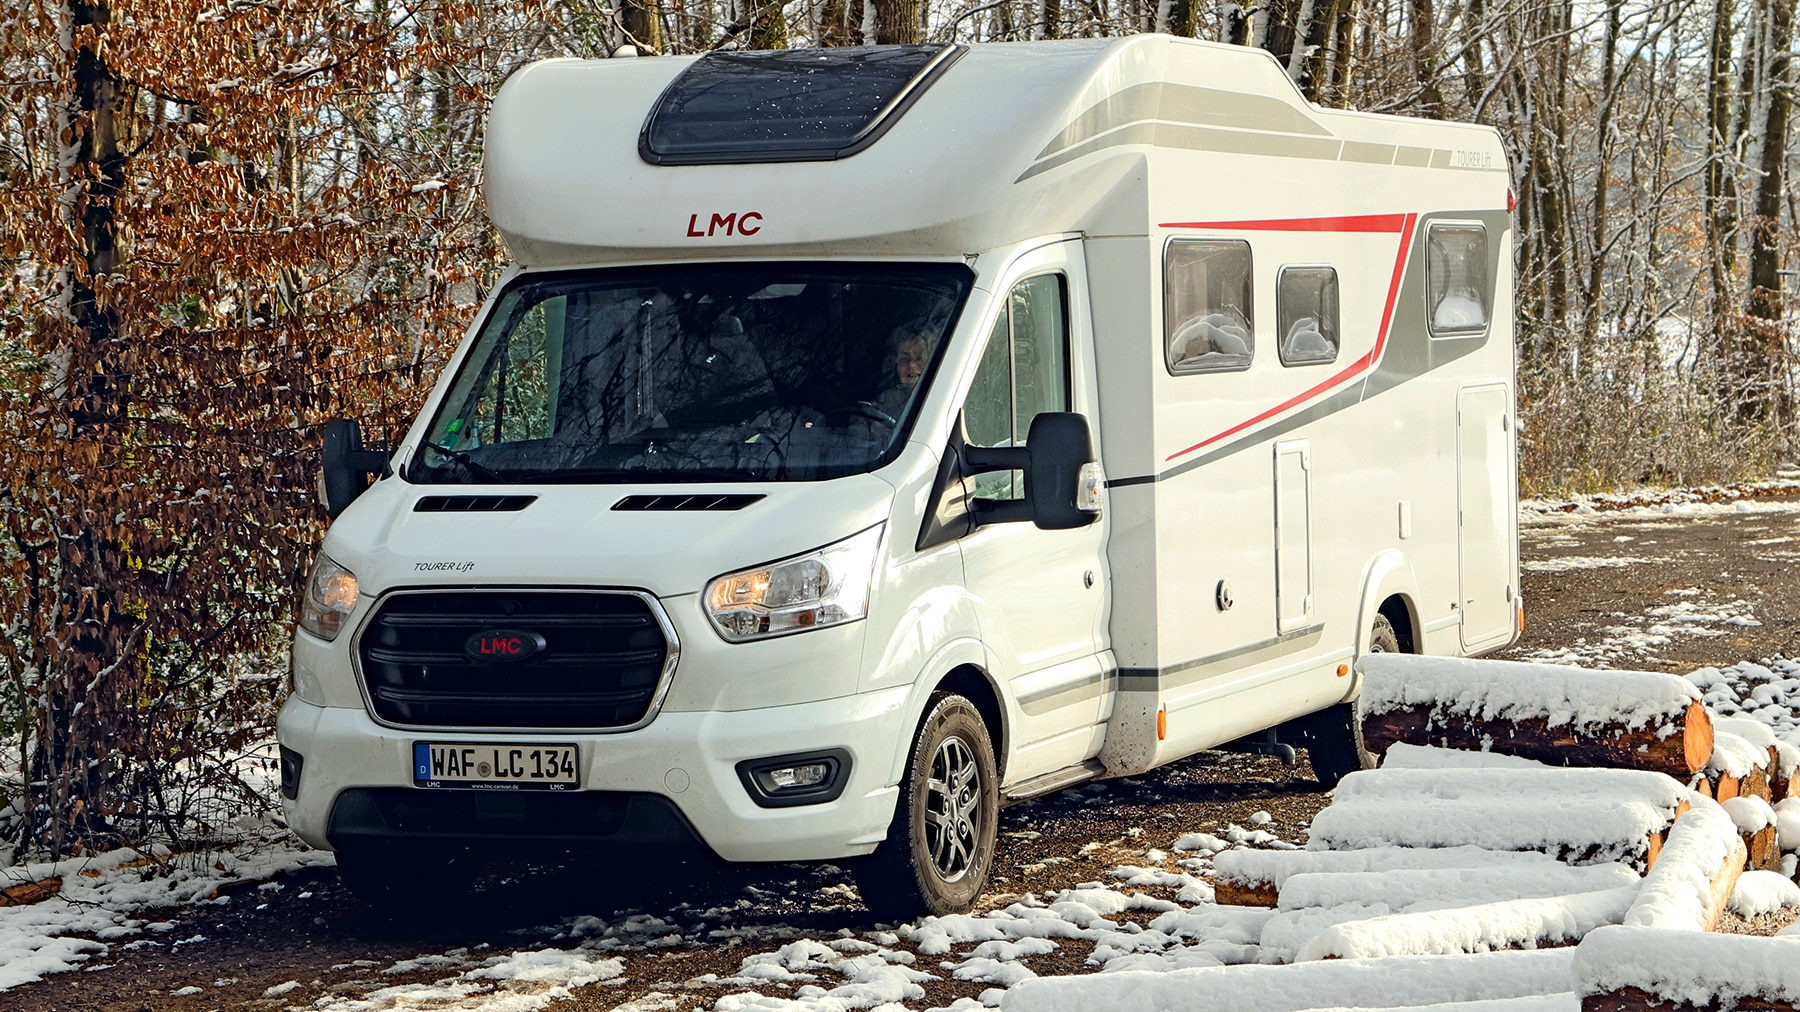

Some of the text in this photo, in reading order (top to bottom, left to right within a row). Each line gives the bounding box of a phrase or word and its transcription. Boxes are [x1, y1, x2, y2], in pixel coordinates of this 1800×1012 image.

[1457, 150, 1480, 167] TOURER
[687, 211, 763, 237] LMC
[414, 561, 475, 573] TOURER Lift
[480, 637, 521, 654] LMC
[420, 748, 574, 779] D WAF LC 134
